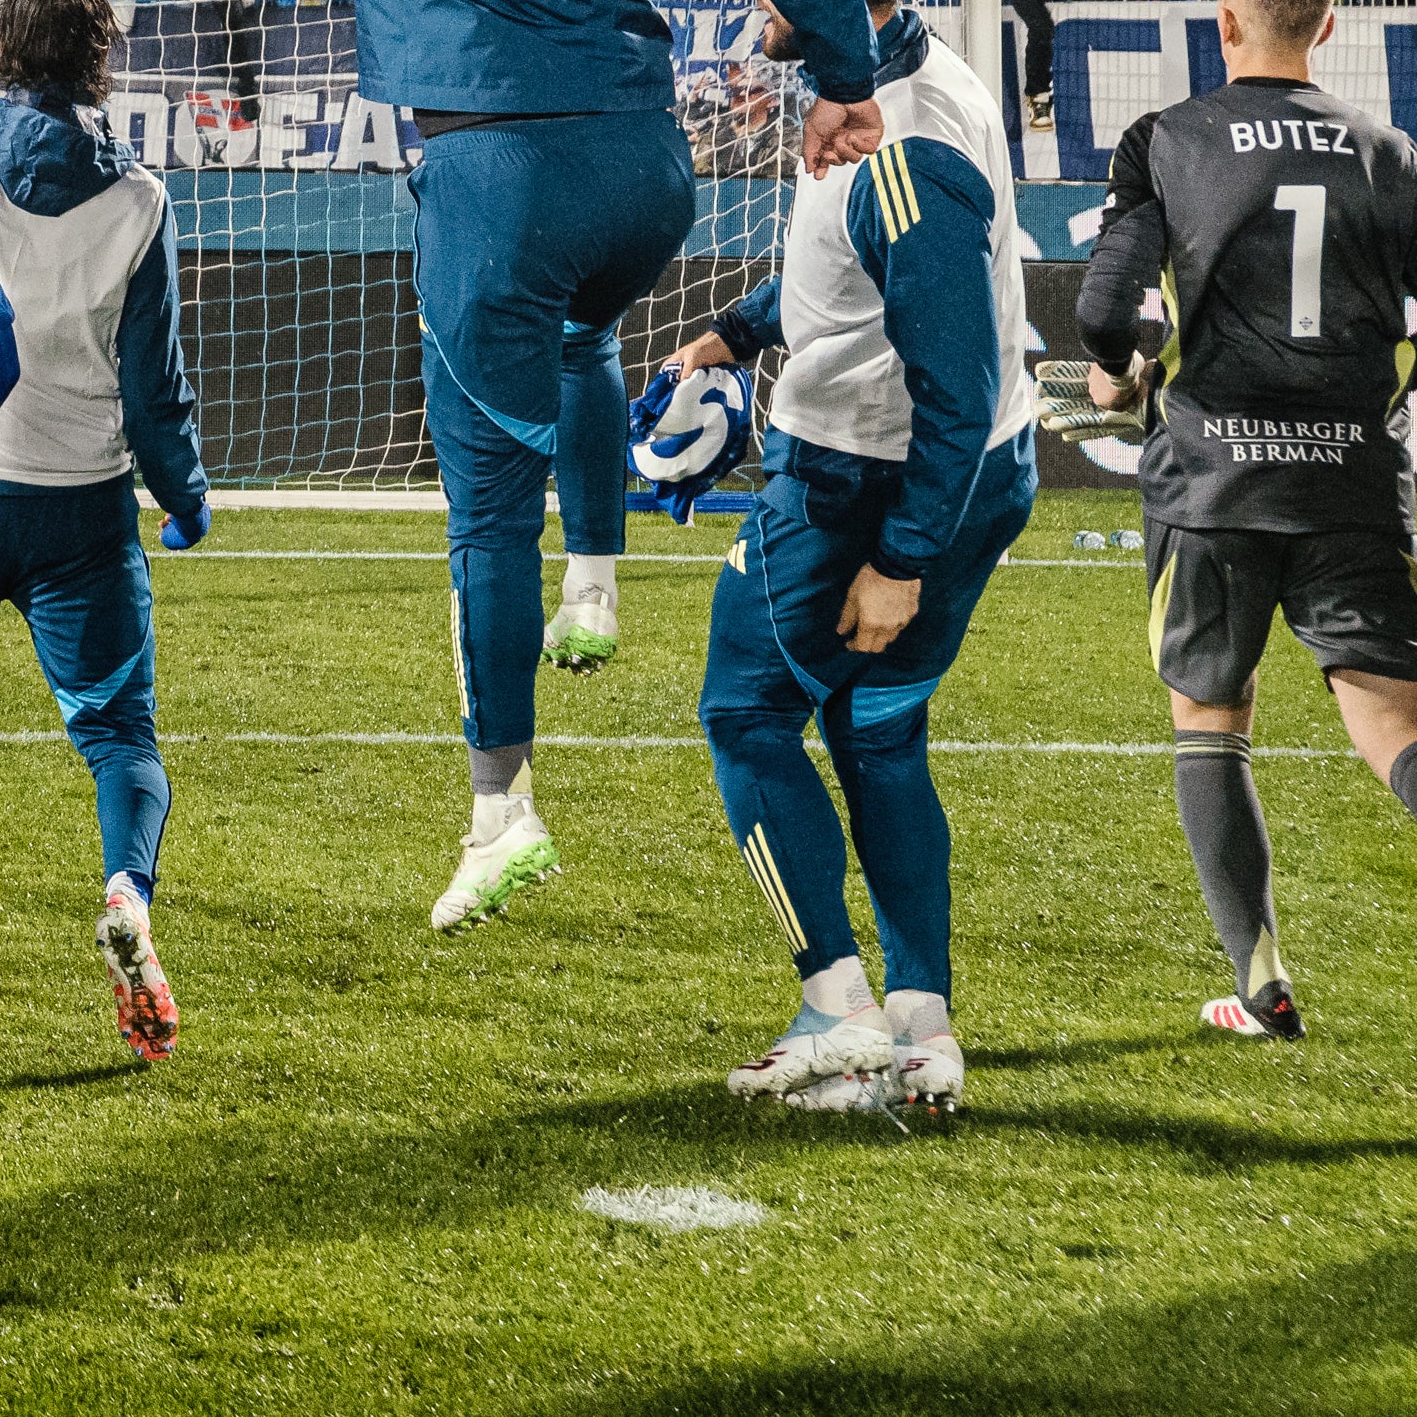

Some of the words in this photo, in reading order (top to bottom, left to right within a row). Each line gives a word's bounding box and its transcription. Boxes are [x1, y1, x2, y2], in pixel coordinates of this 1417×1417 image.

[1228, 119, 1355, 155] BUTEZ
[1274, 184, 1327, 338] 1
[1202, 418, 1366, 444] NEUBERGER
[1232, 443, 1344, 465] BERMAN
